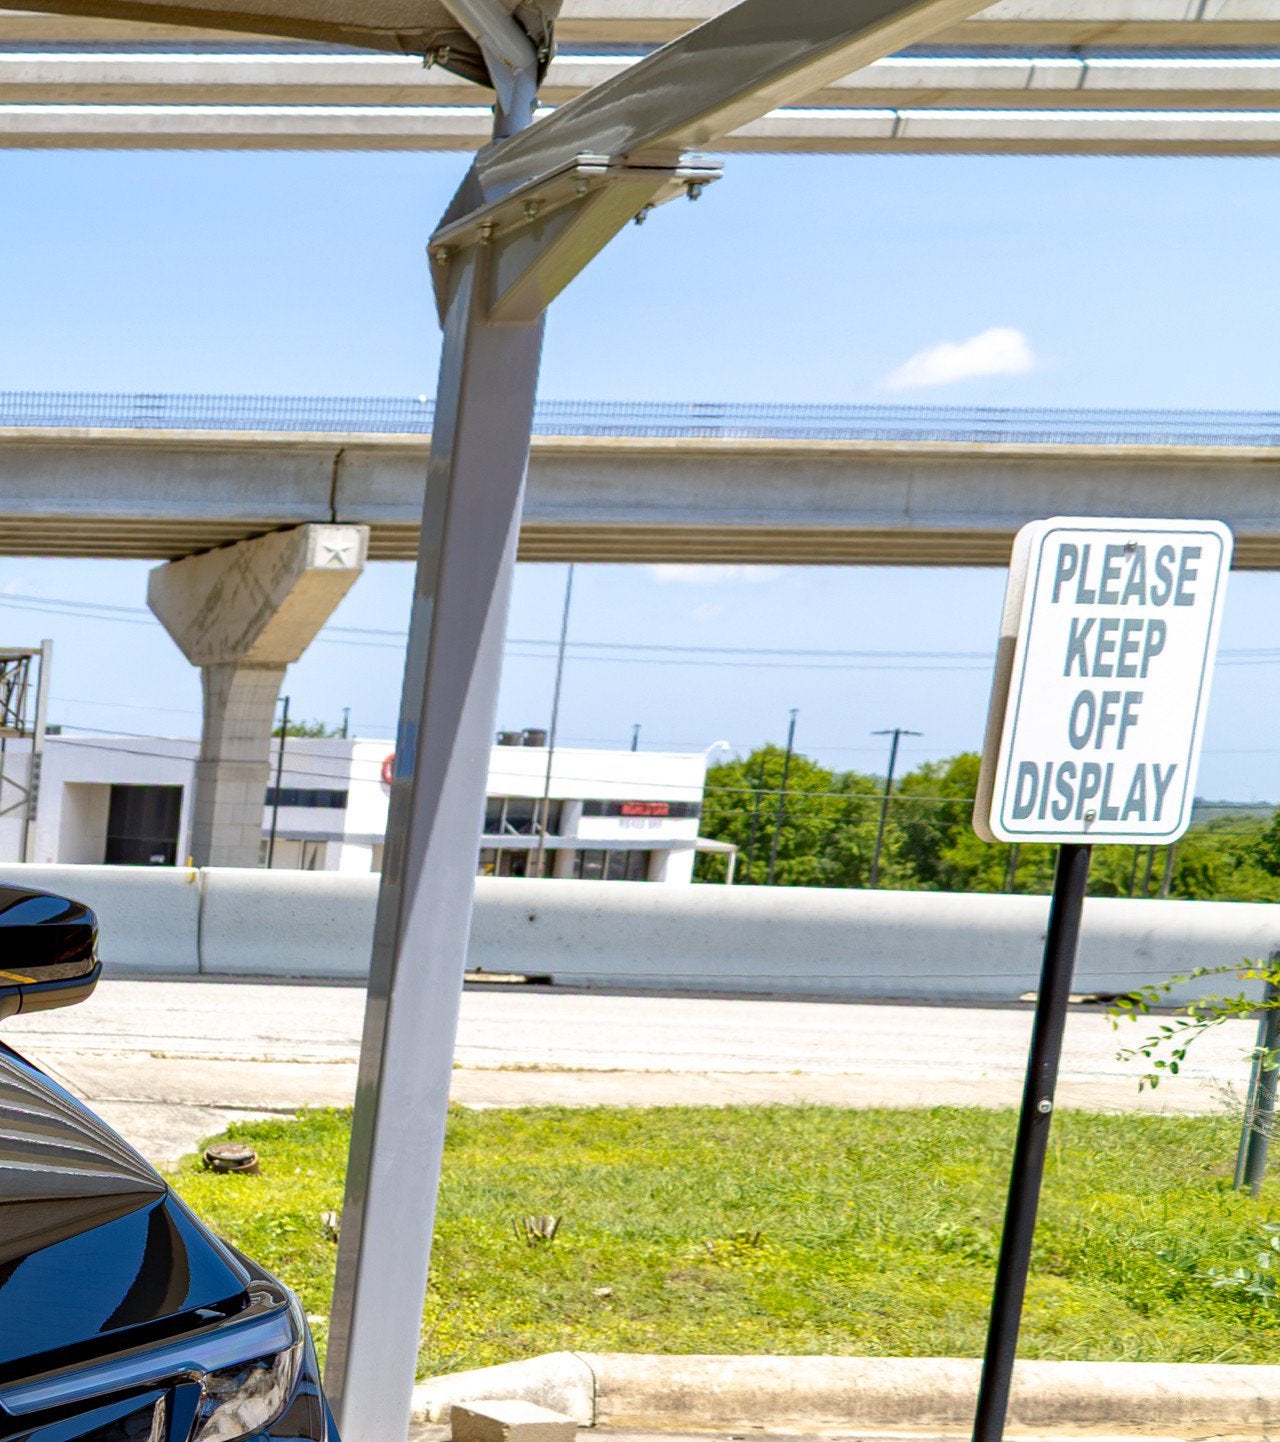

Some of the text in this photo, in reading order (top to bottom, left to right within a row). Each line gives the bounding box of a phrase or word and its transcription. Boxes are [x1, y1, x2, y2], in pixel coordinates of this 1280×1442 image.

[1051, 543, 1203, 607] PLEASE
[1063, 617, 1167, 679] KEEP
[1068, 689, 1144, 751] OFF
[1011, 760, 1178, 822] DISPLAY
